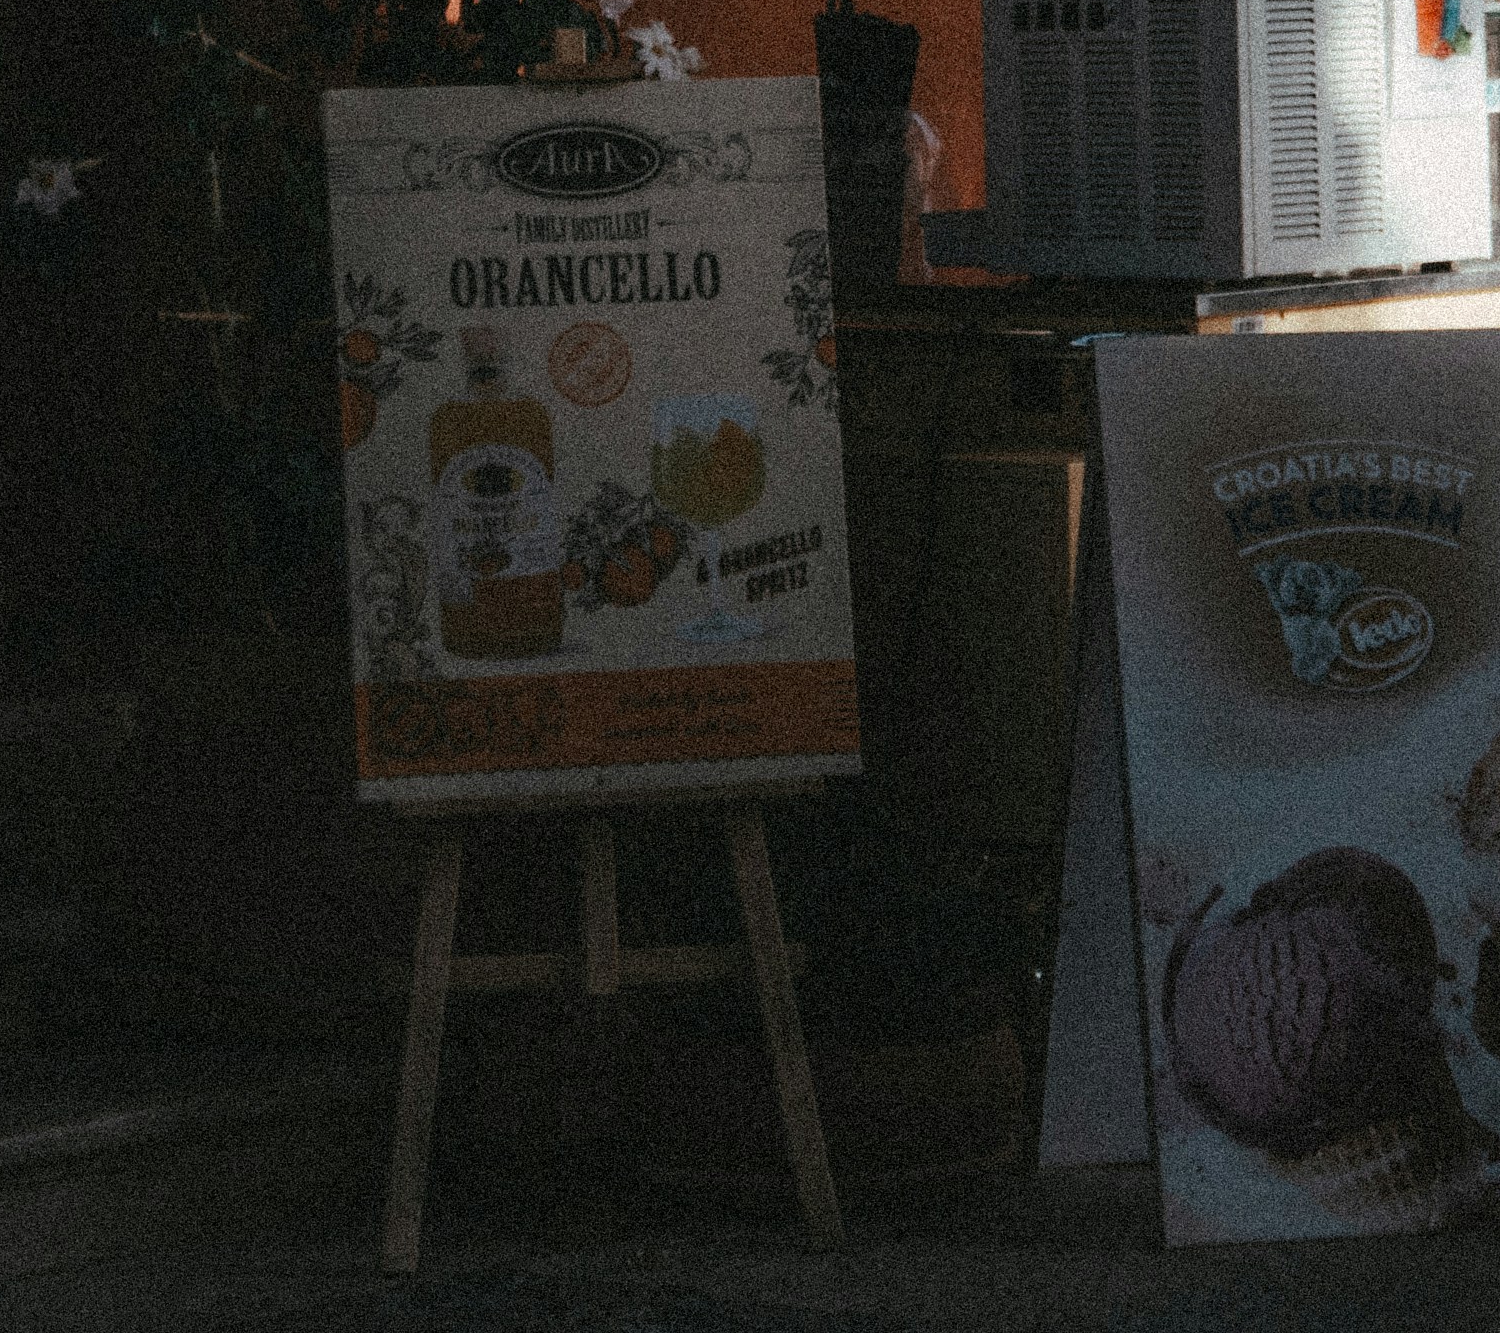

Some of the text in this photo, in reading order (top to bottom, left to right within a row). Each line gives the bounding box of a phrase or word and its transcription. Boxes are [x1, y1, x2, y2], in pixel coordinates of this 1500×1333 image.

[449, 250, 722, 310] ORANCELLO
[1211, 451, 1477, 504] CROATIA'S BEST
[1224, 483, 1464, 544] ICE CREAM
